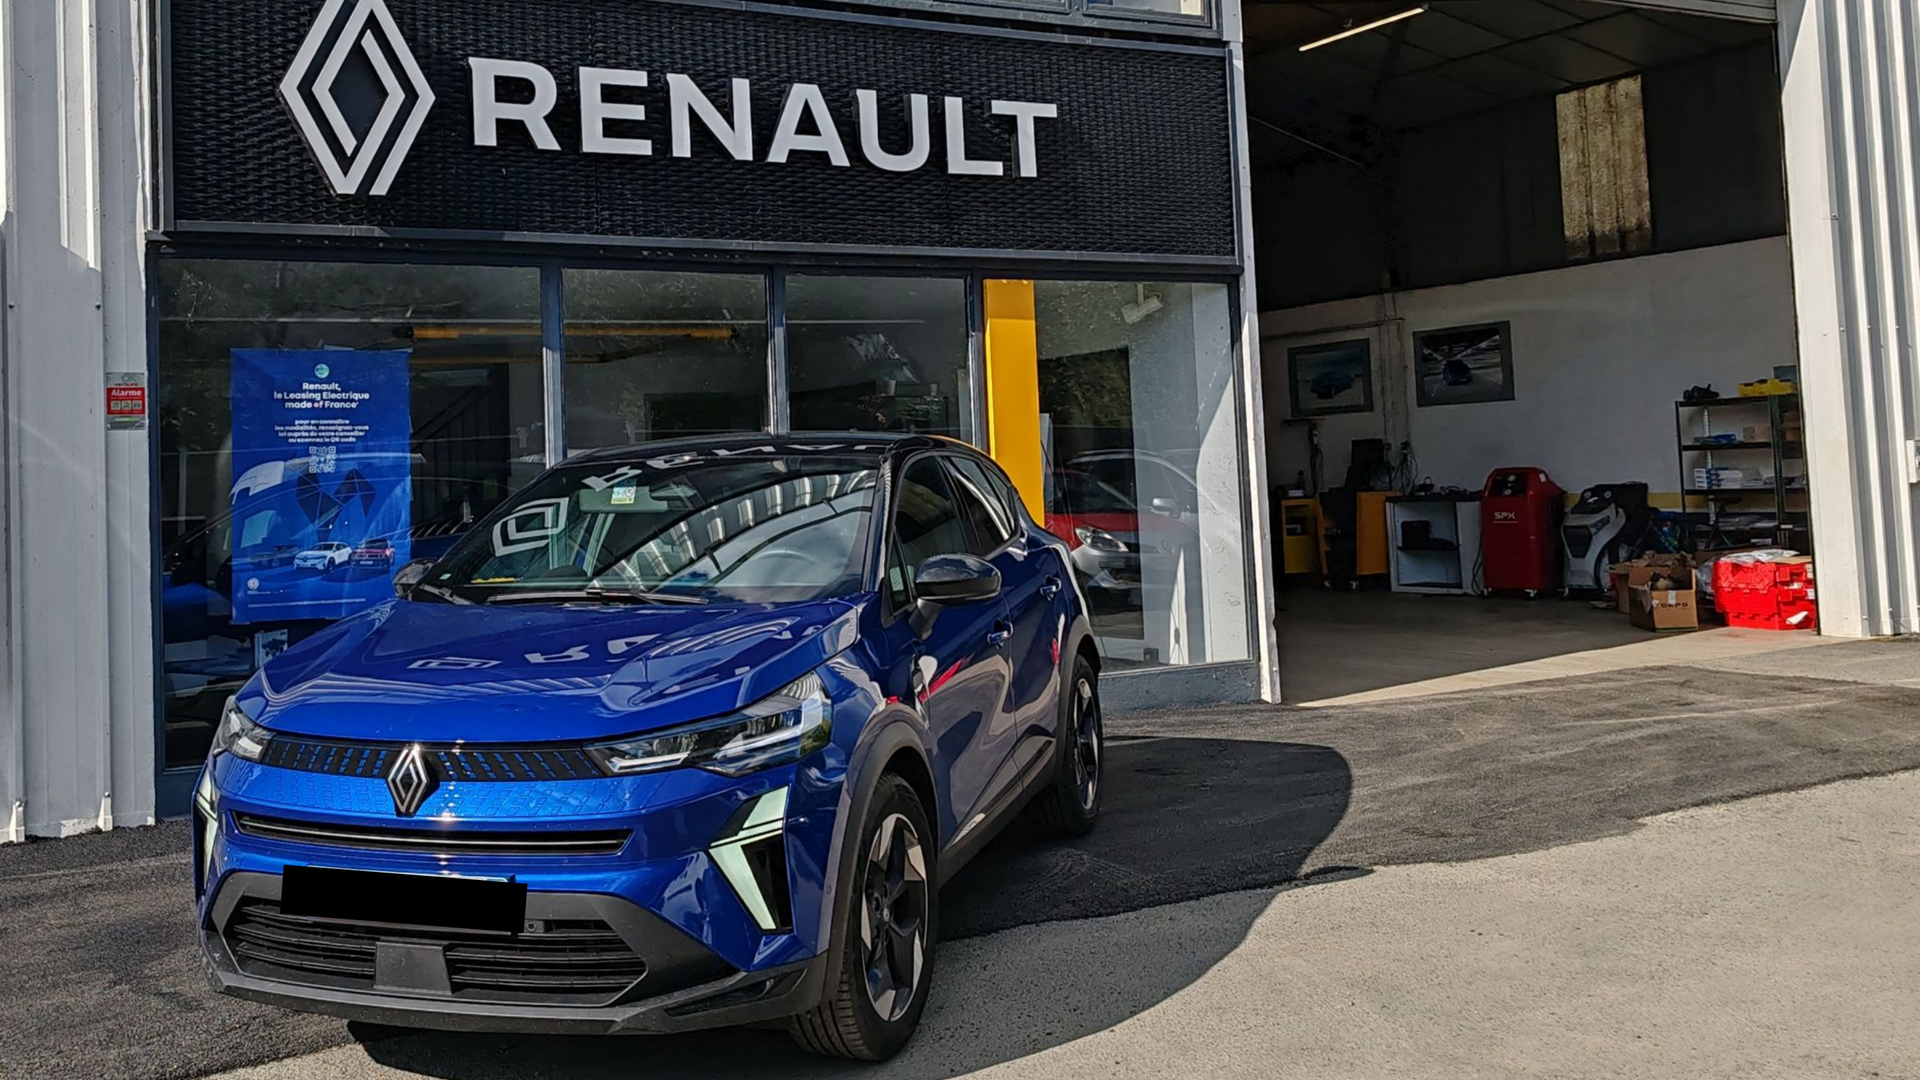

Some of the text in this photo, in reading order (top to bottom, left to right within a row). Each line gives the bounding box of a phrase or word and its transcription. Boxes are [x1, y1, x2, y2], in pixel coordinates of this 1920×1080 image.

[468, 56, 1058, 179] RENAULT
[302, 382, 342, 392] Renault,
[273, 391, 370, 401] le Leasing Electrique
[285, 400, 312, 409] made
[313, 400, 324, 409] of
[1493, 511, 1516, 520] SPX
